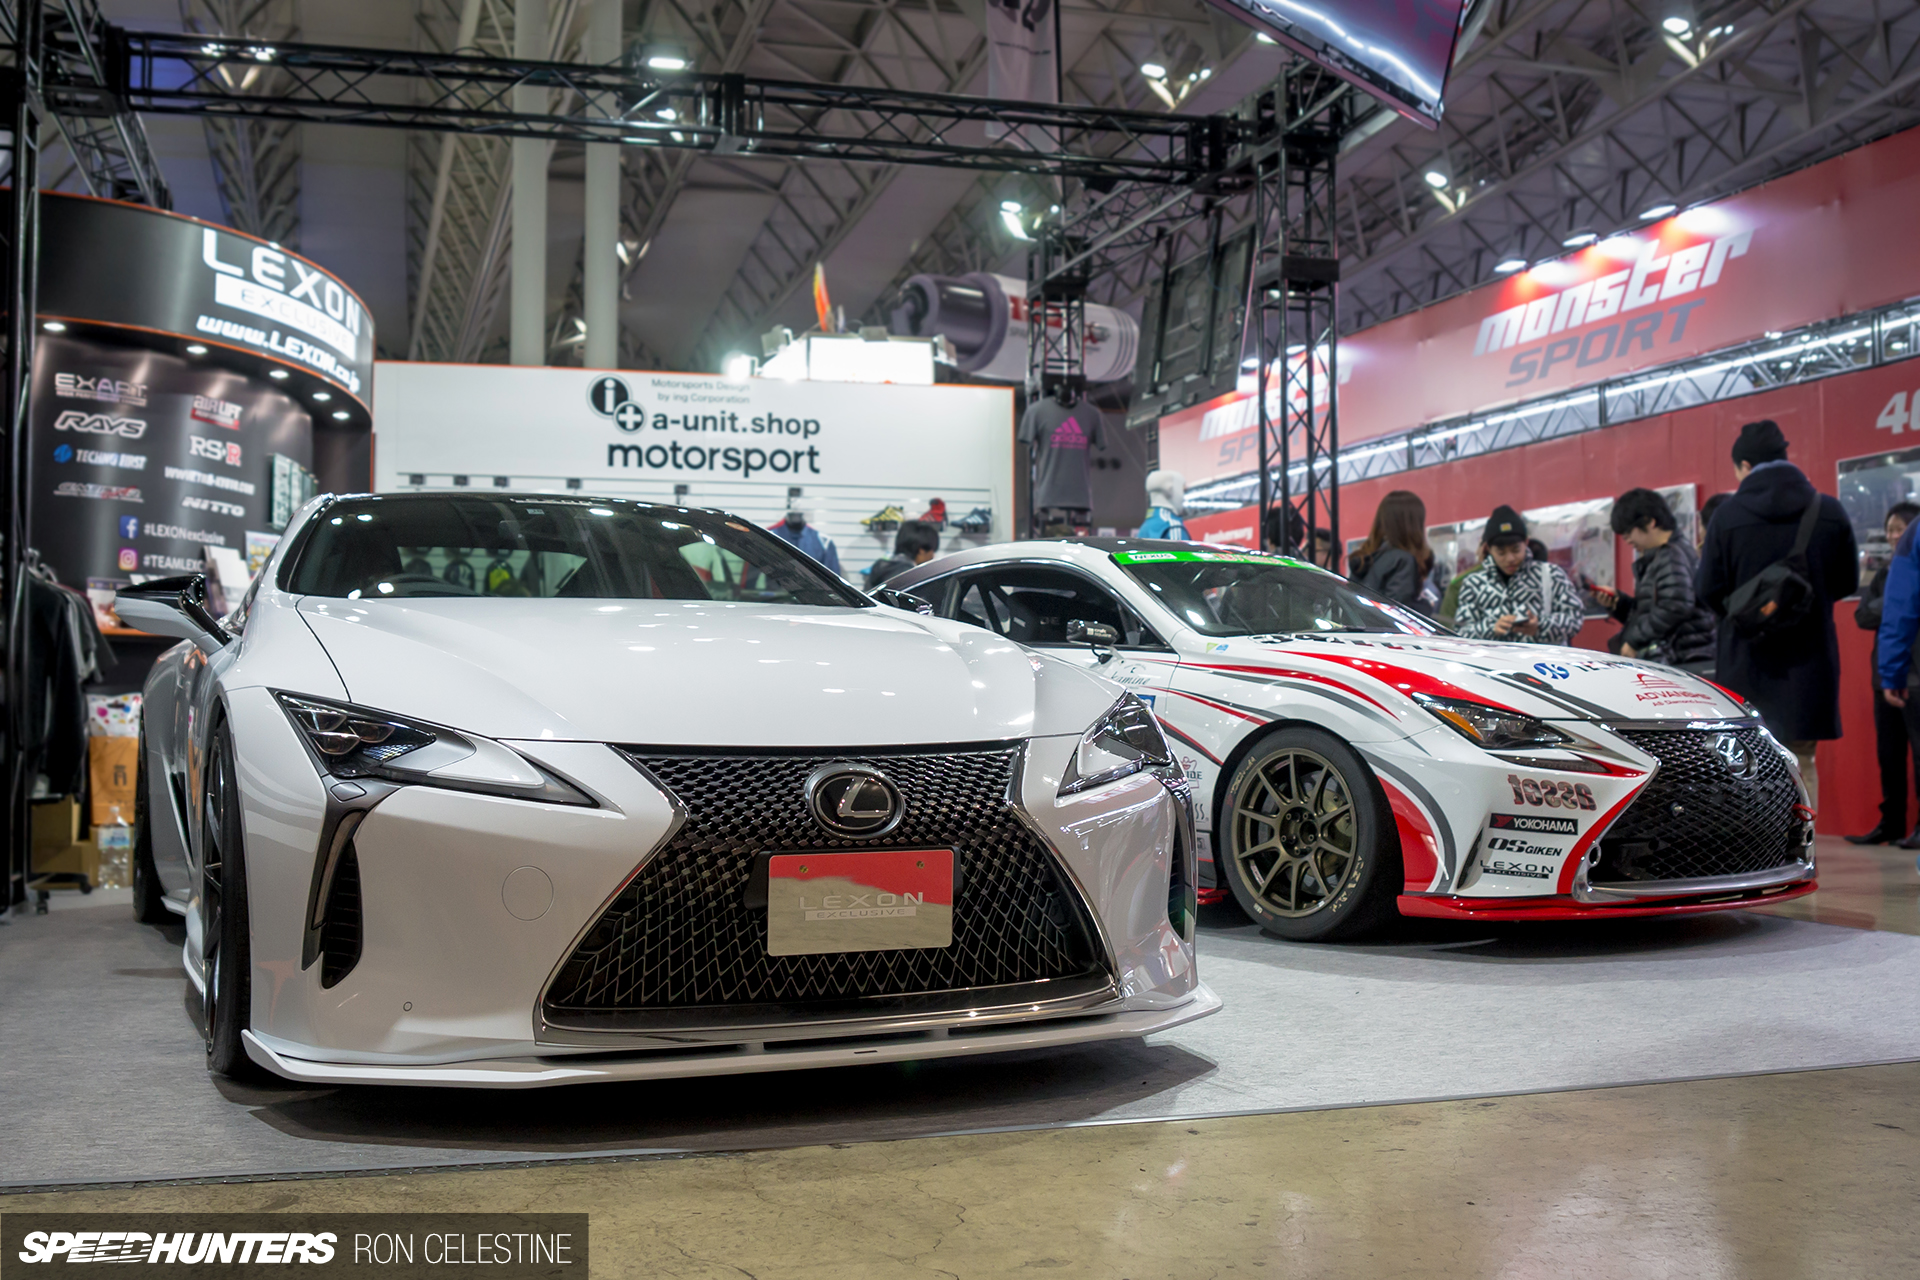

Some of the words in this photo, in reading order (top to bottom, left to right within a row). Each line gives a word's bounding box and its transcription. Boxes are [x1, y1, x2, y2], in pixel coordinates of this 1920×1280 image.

[203, 228, 360, 337] LEXON
[1473, 229, 1757, 357] monster
[241, 288, 349, 348] EXCLUSIVE
[1505, 298, 1706, 389] SPORT
[651, 378, 714, 391] Motorsports
[657, 392, 670, 402] by
[673, 393, 689, 403] ing
[691, 393, 750, 404] Corporation
[54, 410, 147, 439] RAYS
[652, 410, 821, 439] a-unit.shop
[608, 441, 821, 478] motorsport
[182, 496, 245, 517] NITTO
[1513, 817, 1575, 833] YOKOHAMA
[1480, 860, 1554, 874] LEXON
[1488, 868, 1543, 879] EXCLUSIVE
[800, 891, 923, 910] LEXON
[816, 907, 906, 919] EXCLUSIVE
